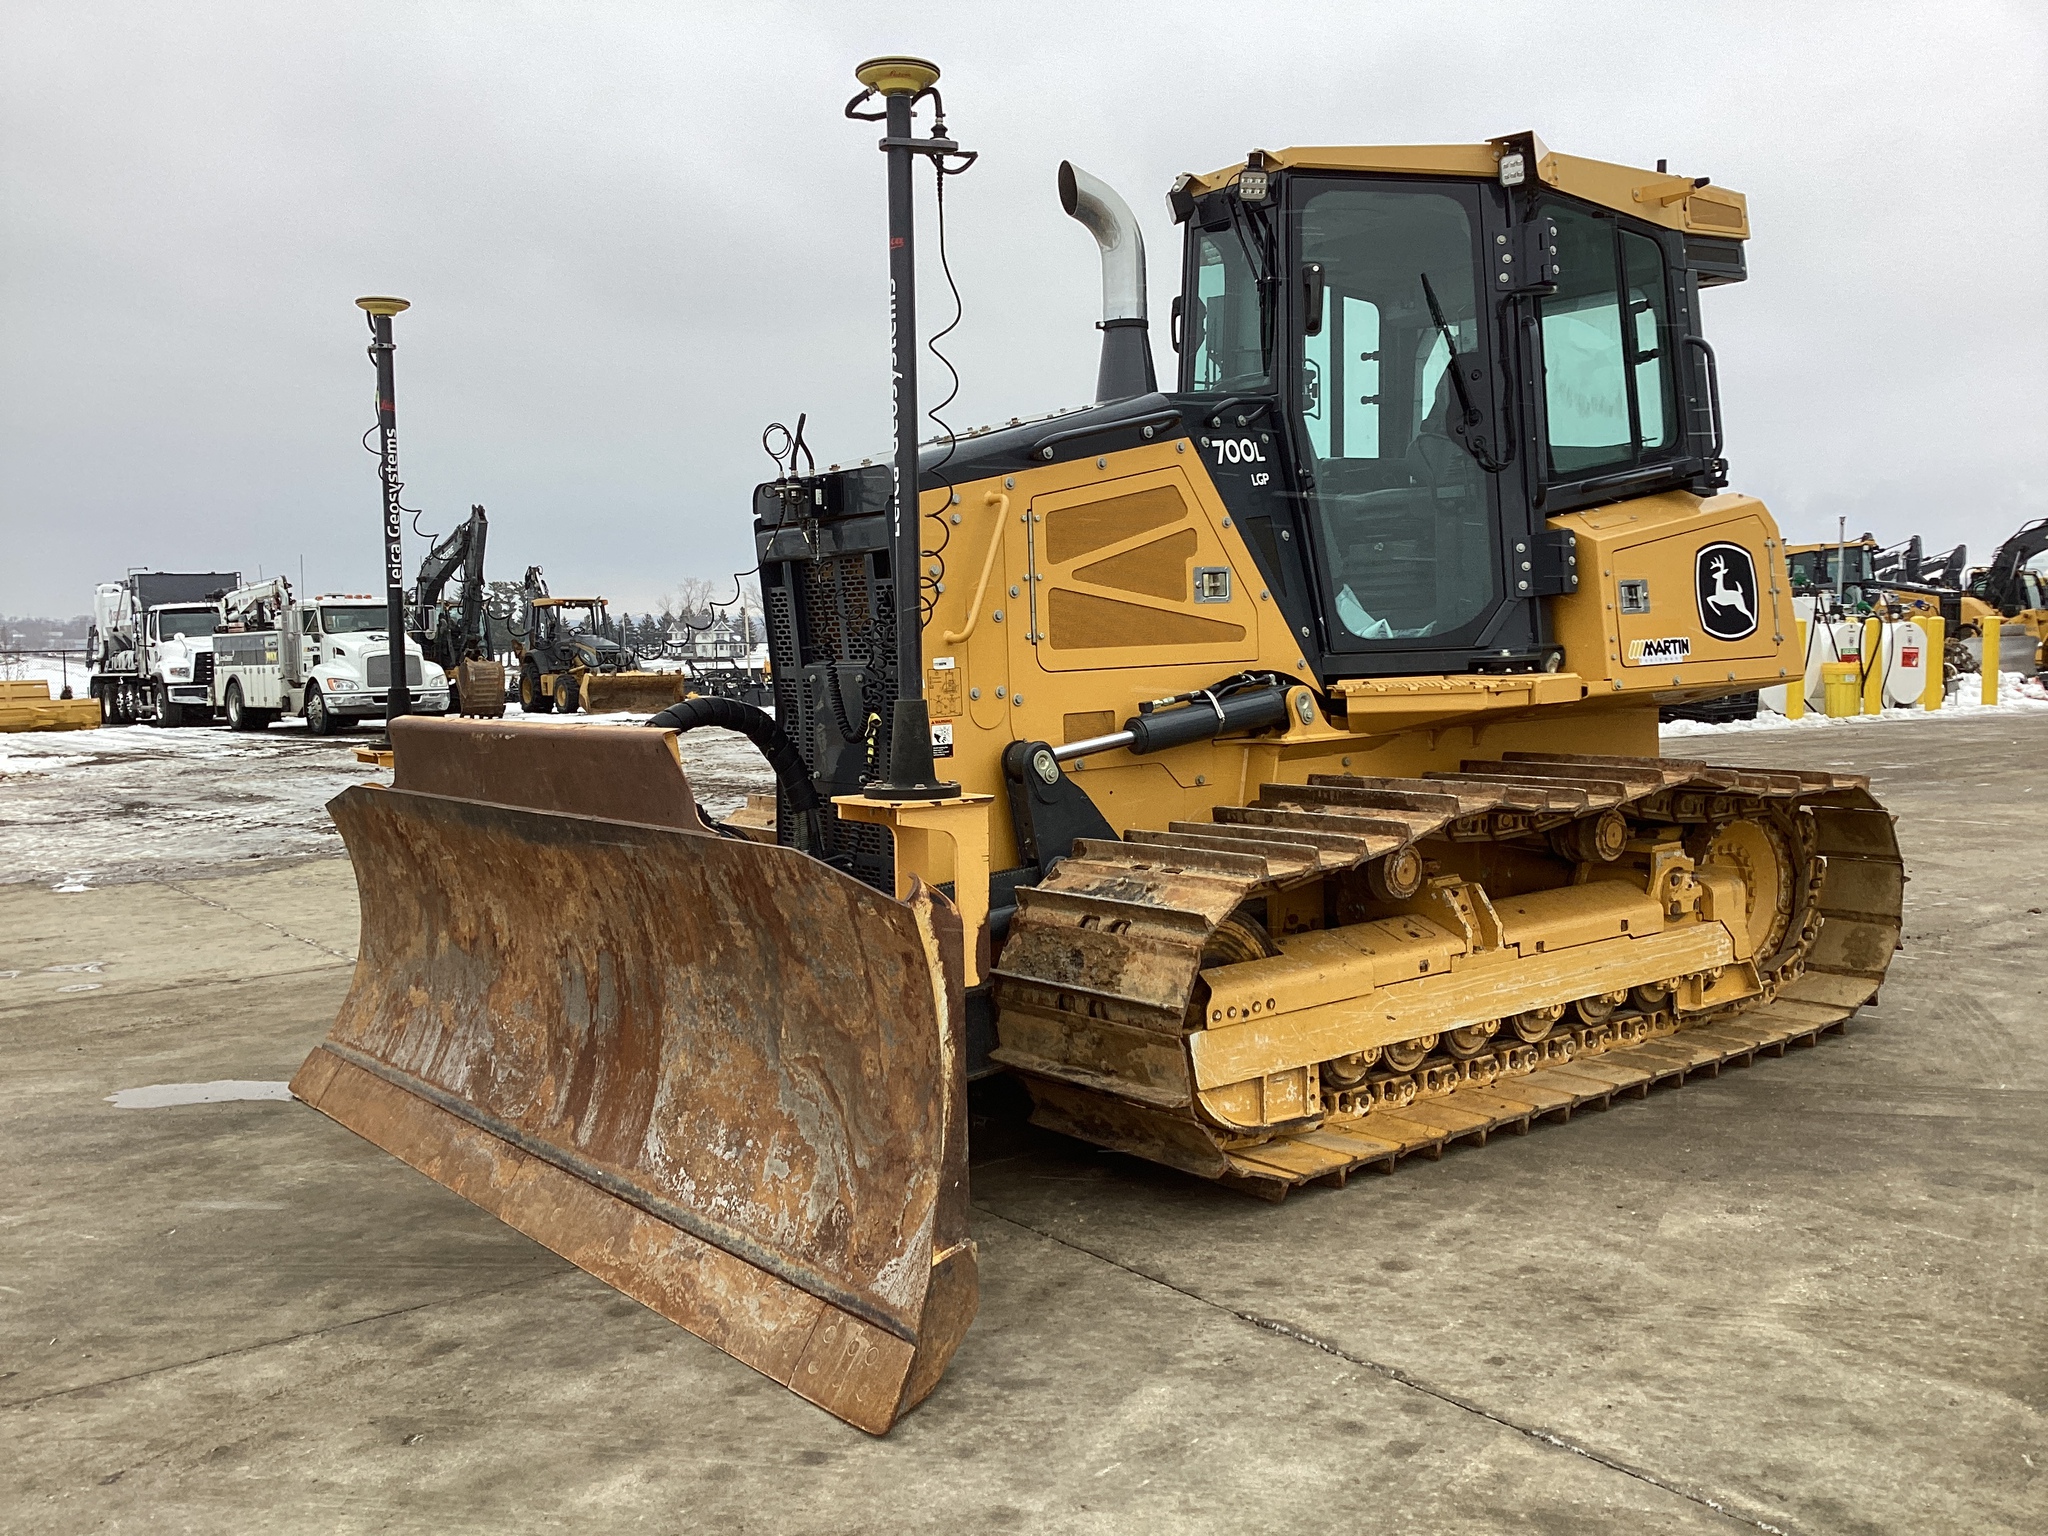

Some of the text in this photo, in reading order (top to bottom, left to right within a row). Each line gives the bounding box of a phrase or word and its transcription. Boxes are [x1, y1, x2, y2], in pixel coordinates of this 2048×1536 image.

[1211, 438, 1266, 465] 700L
[385, 428, 400, 538] Geosystems
[1250, 472, 1270, 487] LGP
[388, 544, 402, 588] Leica
[1642, 638, 1690, 657] MARTIN
